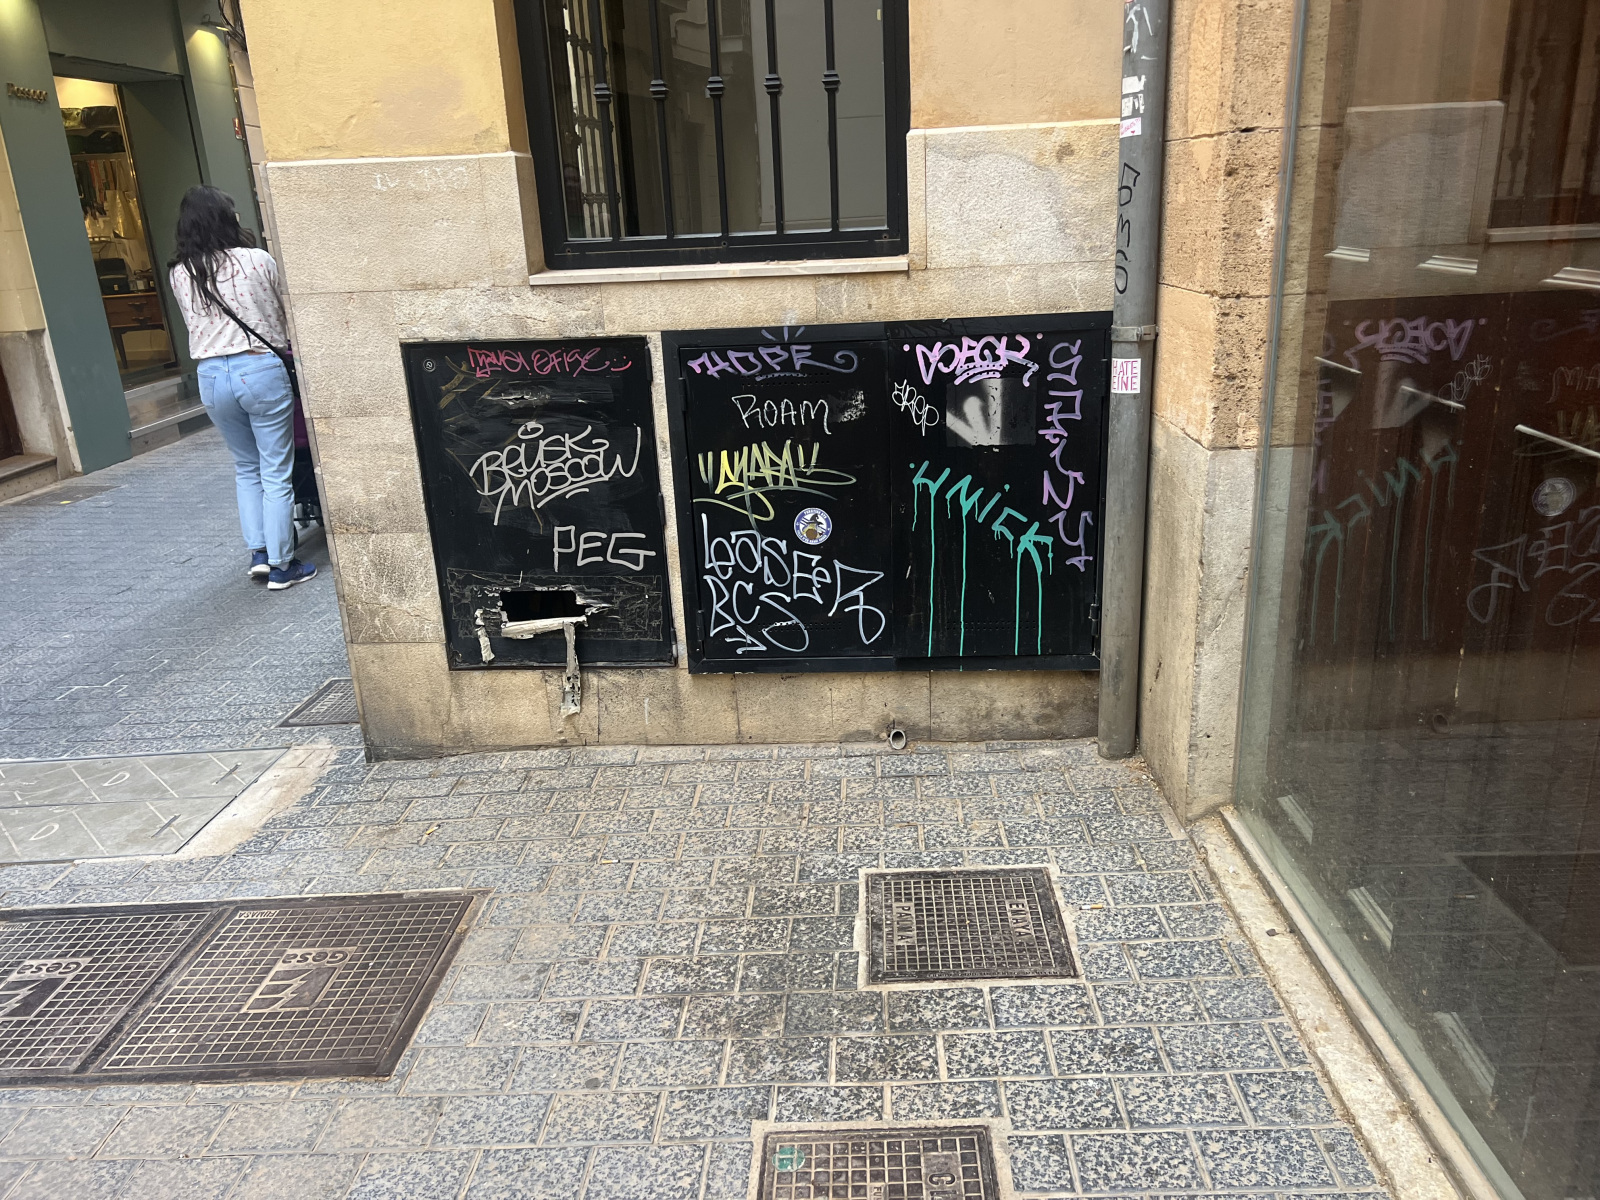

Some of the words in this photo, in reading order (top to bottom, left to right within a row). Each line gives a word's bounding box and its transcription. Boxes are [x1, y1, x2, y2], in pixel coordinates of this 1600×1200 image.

[731, 394, 832, 434] ROAM
[553, 525, 656, 572] PEG
[17, 961, 82, 975] Gesa
[281, 951, 349, 964] Gesa
